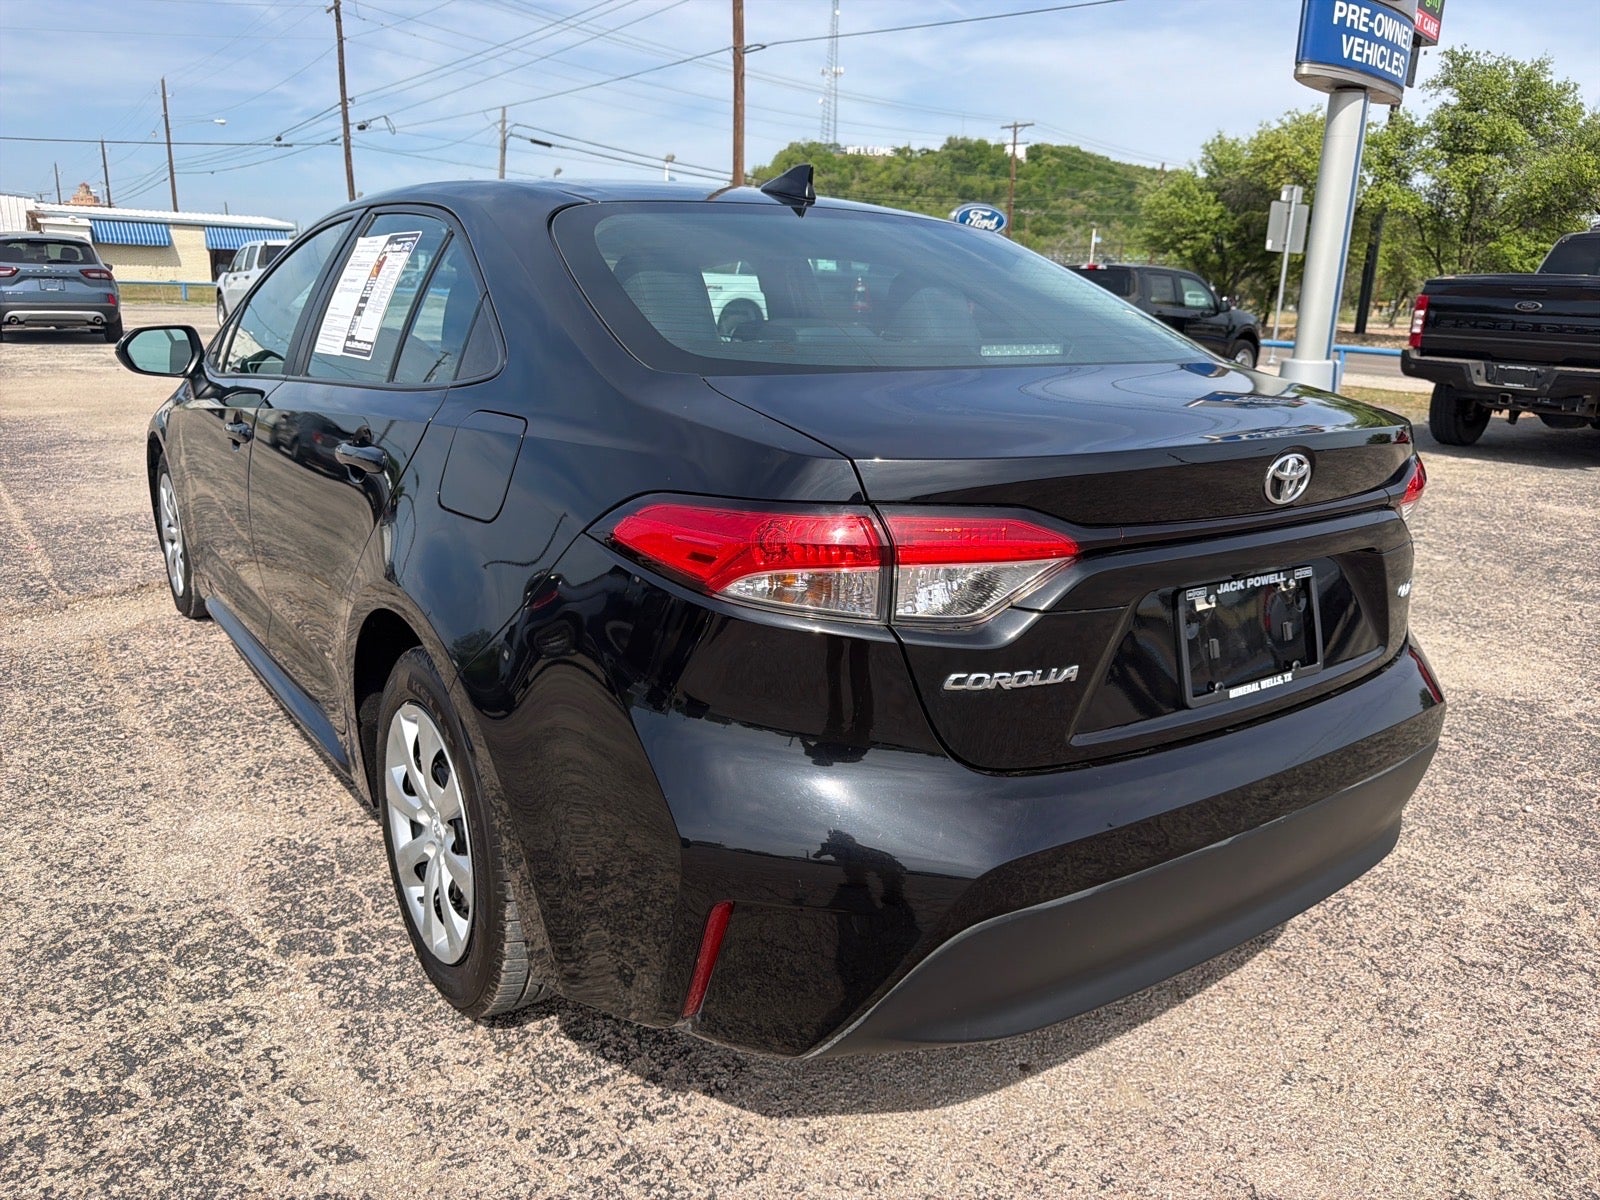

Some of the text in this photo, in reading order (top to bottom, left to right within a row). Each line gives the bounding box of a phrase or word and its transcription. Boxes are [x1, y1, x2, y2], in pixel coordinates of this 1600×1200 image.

[1333, 1, 1412, 51] PRE-OWNED
[1423, 18, 1438, 37] CARE
[1342, 34, 1405, 78] VEHICLES
[966, 209, 999, 231] Ford
[1216, 572, 1287, 594] JACK POWELL
[943, 664, 1080, 690] COROLLA
[1283, 672, 1293, 683] TX
